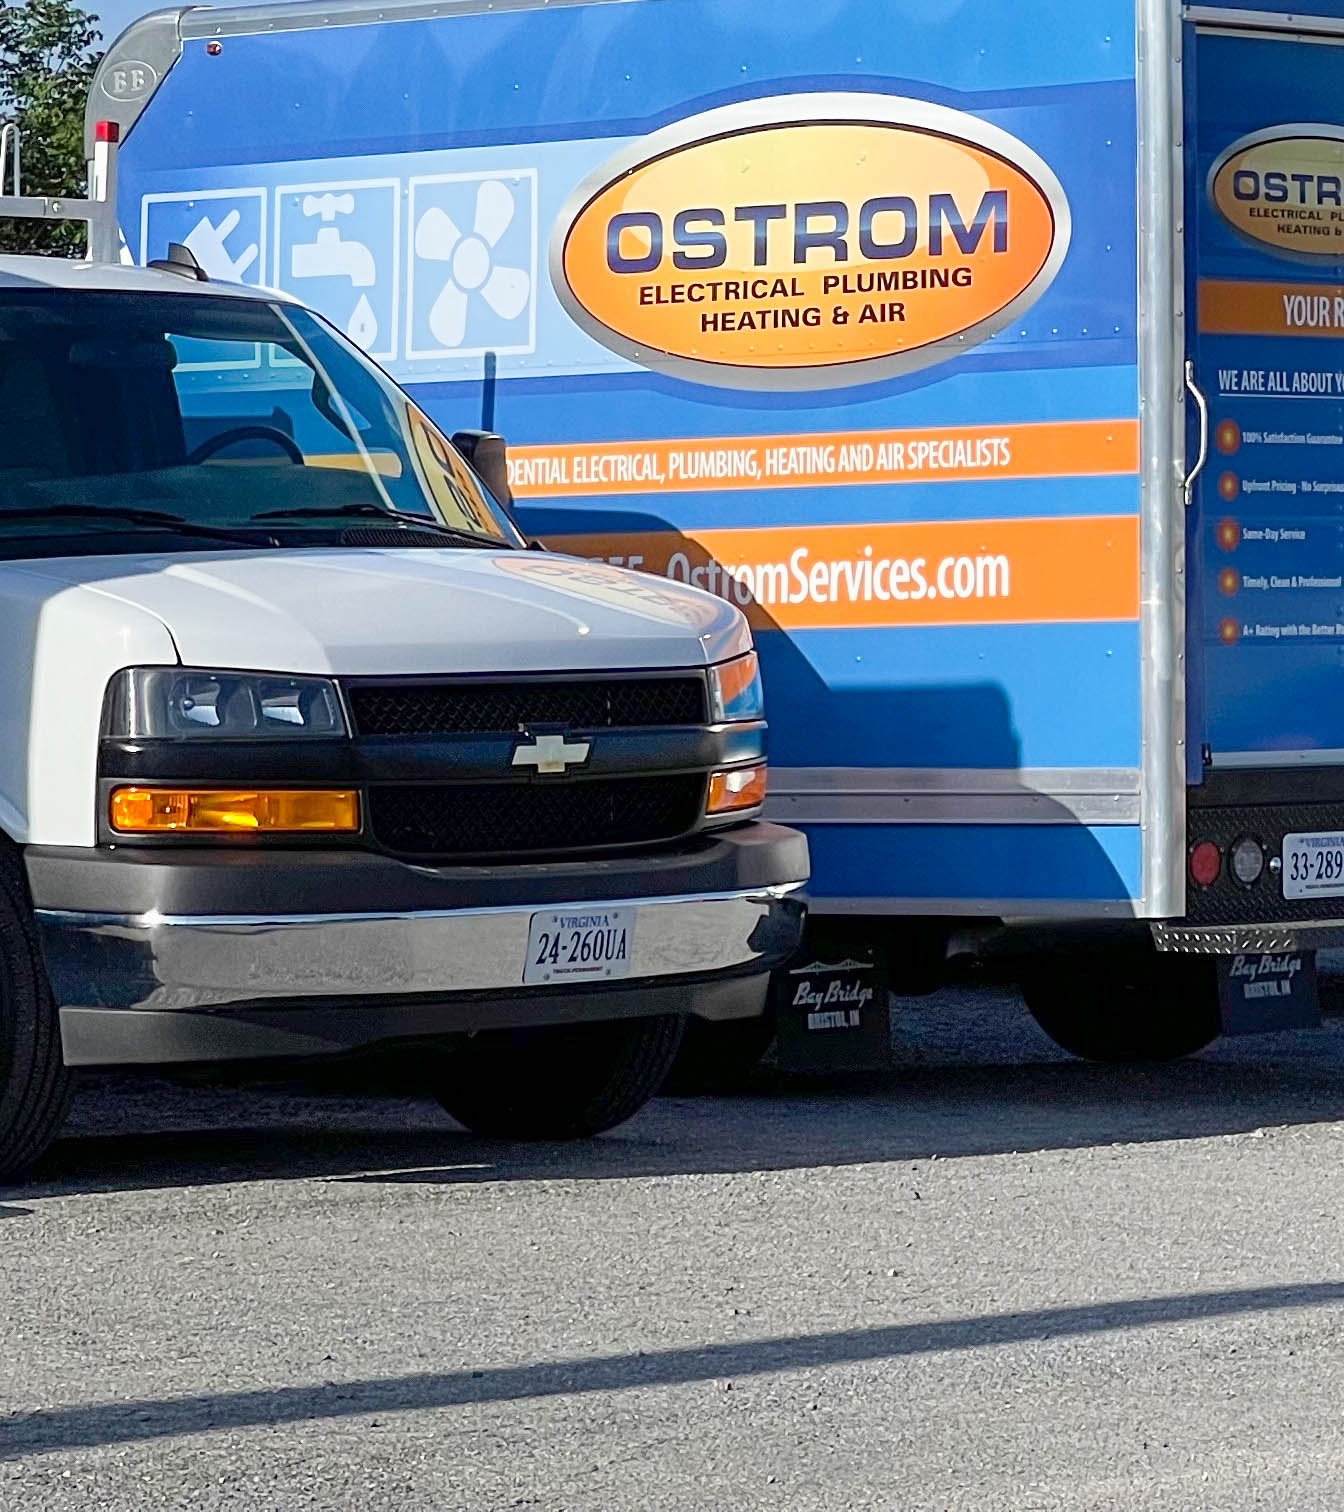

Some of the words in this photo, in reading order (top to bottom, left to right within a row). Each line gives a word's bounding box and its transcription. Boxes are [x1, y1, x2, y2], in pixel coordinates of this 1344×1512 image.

[1249, 207, 1323, 221] ELECTRICAL
[1277, 223, 1330, 236] HEATING
[606, 190, 1008, 274] OSTROM
[639, 278, 805, 306] ELECTRICAL
[823, 267, 973, 296] PLUMBING
[701, 307, 821, 333] HEATING
[832, 306, 850, 325] &
[858, 302, 906, 325] AIR
[1283, 295, 1330, 327] YOUR
[1218, 369, 1238, 391] WE
[1240, 370, 1265, 391] ARE
[1267, 371, 1290, 392] ALL
[1292, 372, 1333, 393] ABOUT
[506, 457, 570, 486] DENTIAL
[572, 453, 666, 484] ELECTRICAL,
[668, 449, 762, 480] PLUMBING,
[765, 445, 835, 476] HEATING
[837, 443, 874, 472] AND
[876, 442, 905, 471] AIR
[907, 438, 1011, 469] SPECIALISTS
[667, 545, 1010, 605] OstromServices.com
[560, 914, 609, 928] VIRGINIA
[535, 928, 626, 965] 24-260UA
[792, 980, 824, 1011] Bay
[824, 979, 873, 1008] Bridge
